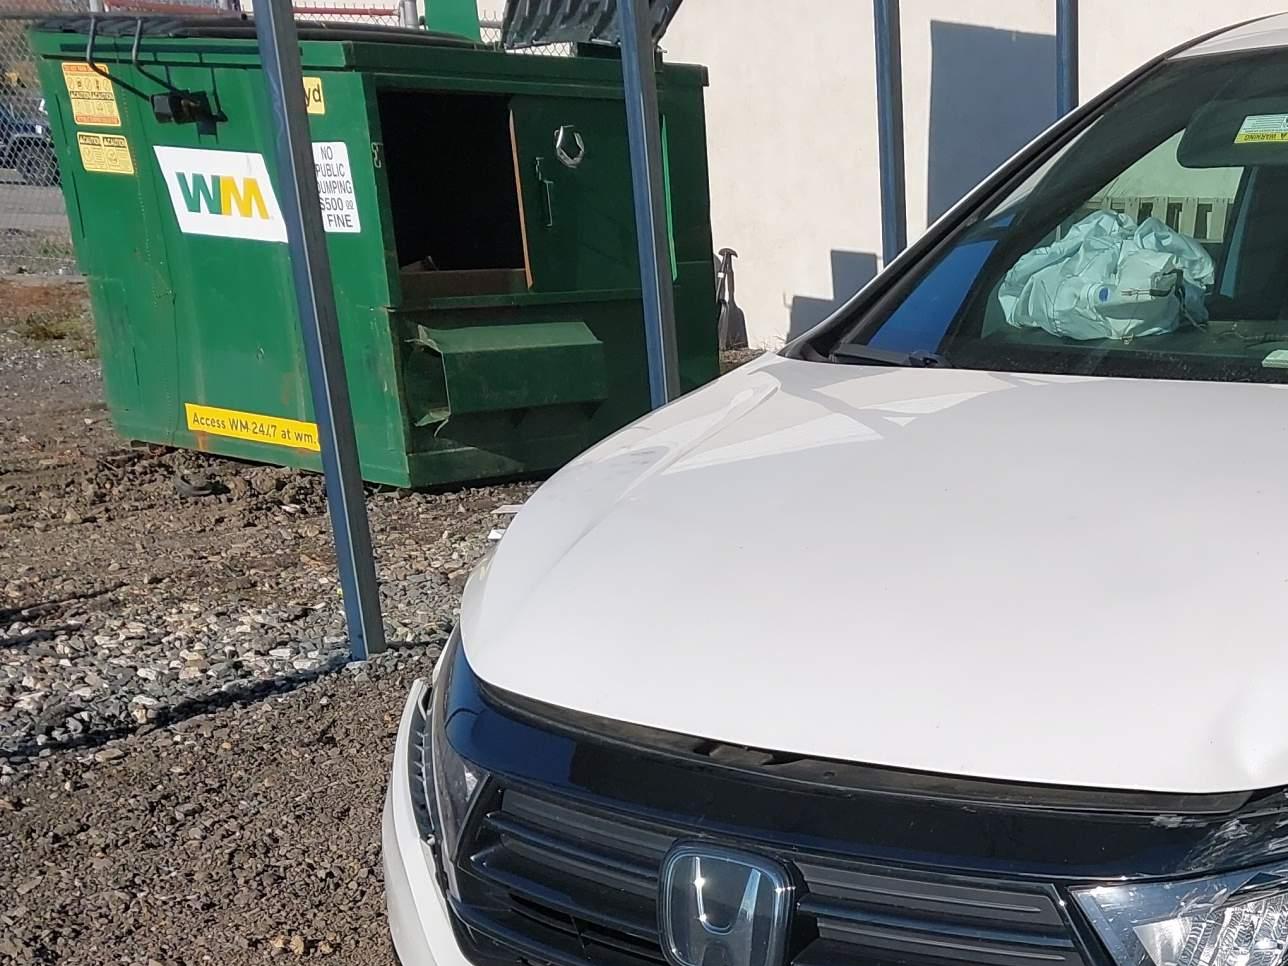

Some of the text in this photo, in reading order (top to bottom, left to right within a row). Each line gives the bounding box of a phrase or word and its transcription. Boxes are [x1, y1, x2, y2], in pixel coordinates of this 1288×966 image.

[320, 146, 333, 160] NO
[315, 163, 345, 177] PUBLIC
[175, 171, 270, 220] WM
[327, 214, 353, 228] FINE
[193, 412, 226, 428] Access
[229, 418, 250, 432] WM
[252, 422, 277, 438] 24/7
[281, 428, 291, 441] at
